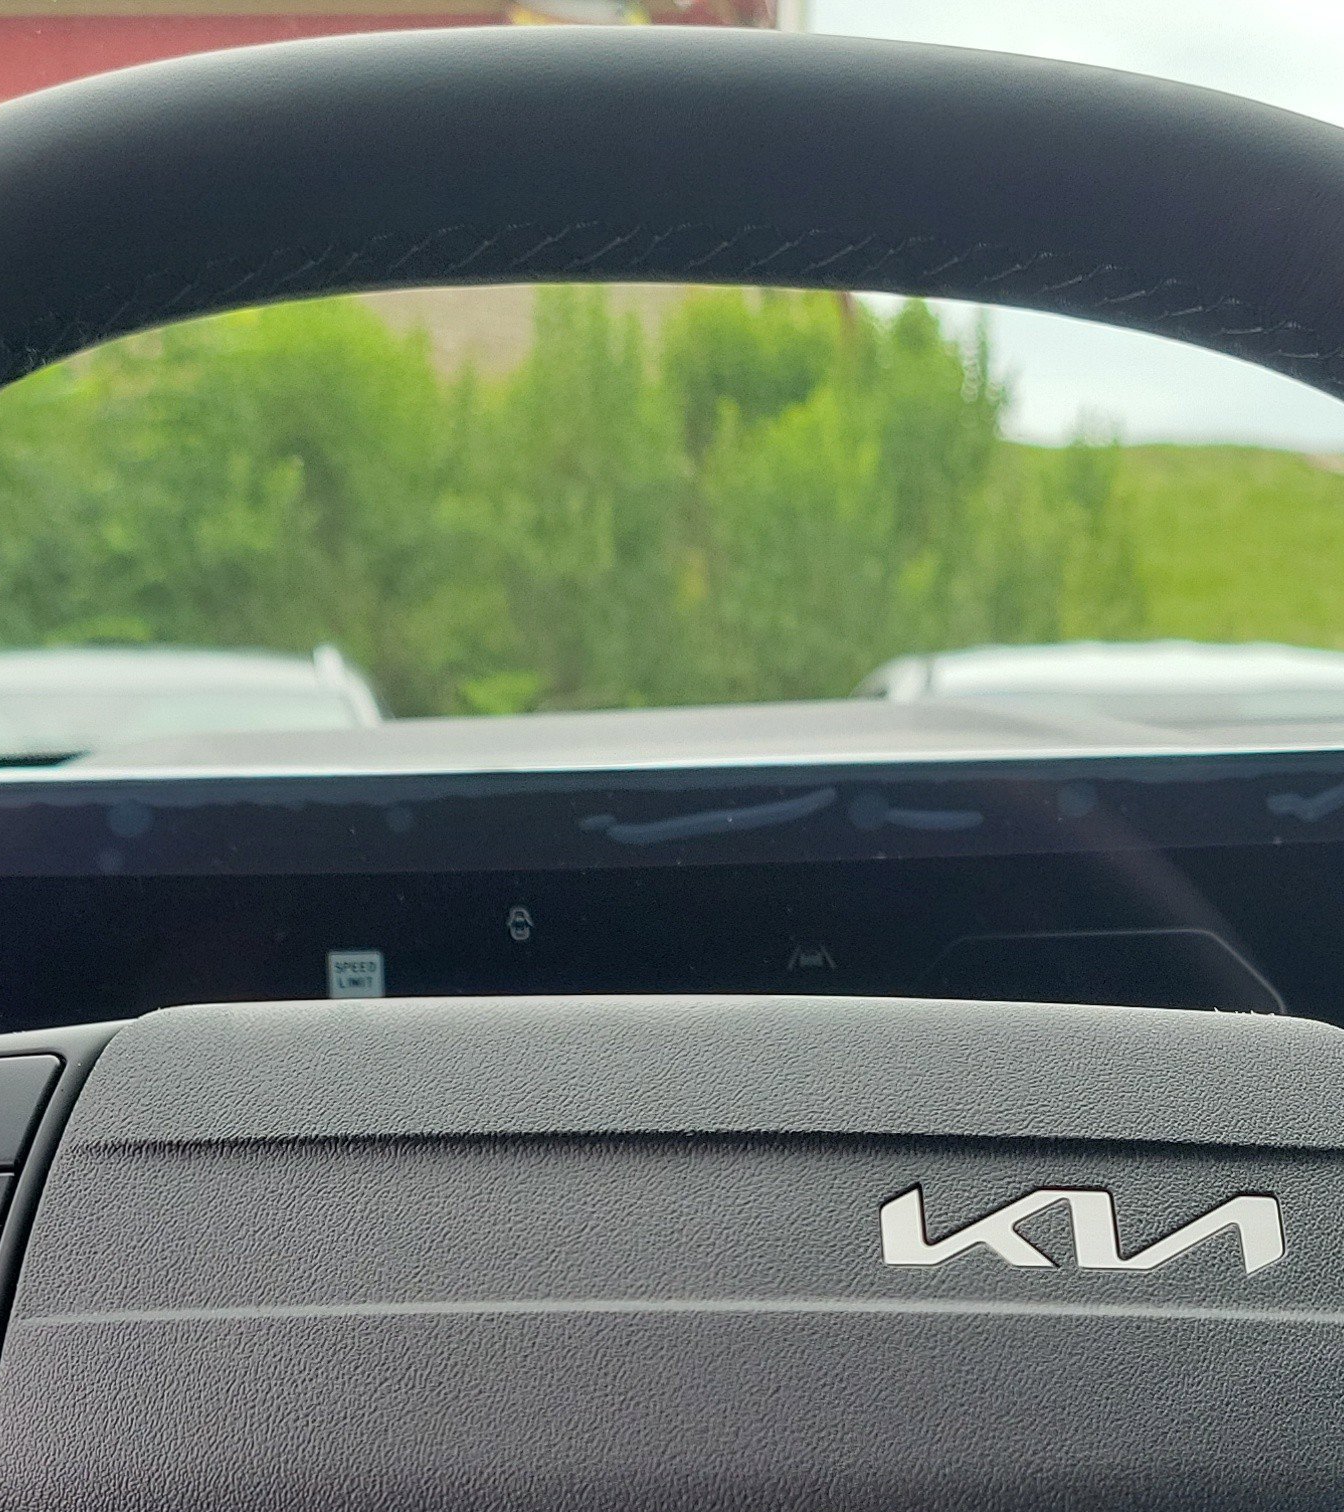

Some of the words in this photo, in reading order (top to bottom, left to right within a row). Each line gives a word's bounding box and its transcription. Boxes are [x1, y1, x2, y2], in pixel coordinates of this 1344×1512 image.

[335, 961, 377, 974] SPEED
[337, 975, 374, 989] LIMIT
[880, 1183, 1285, 1276] KIA
